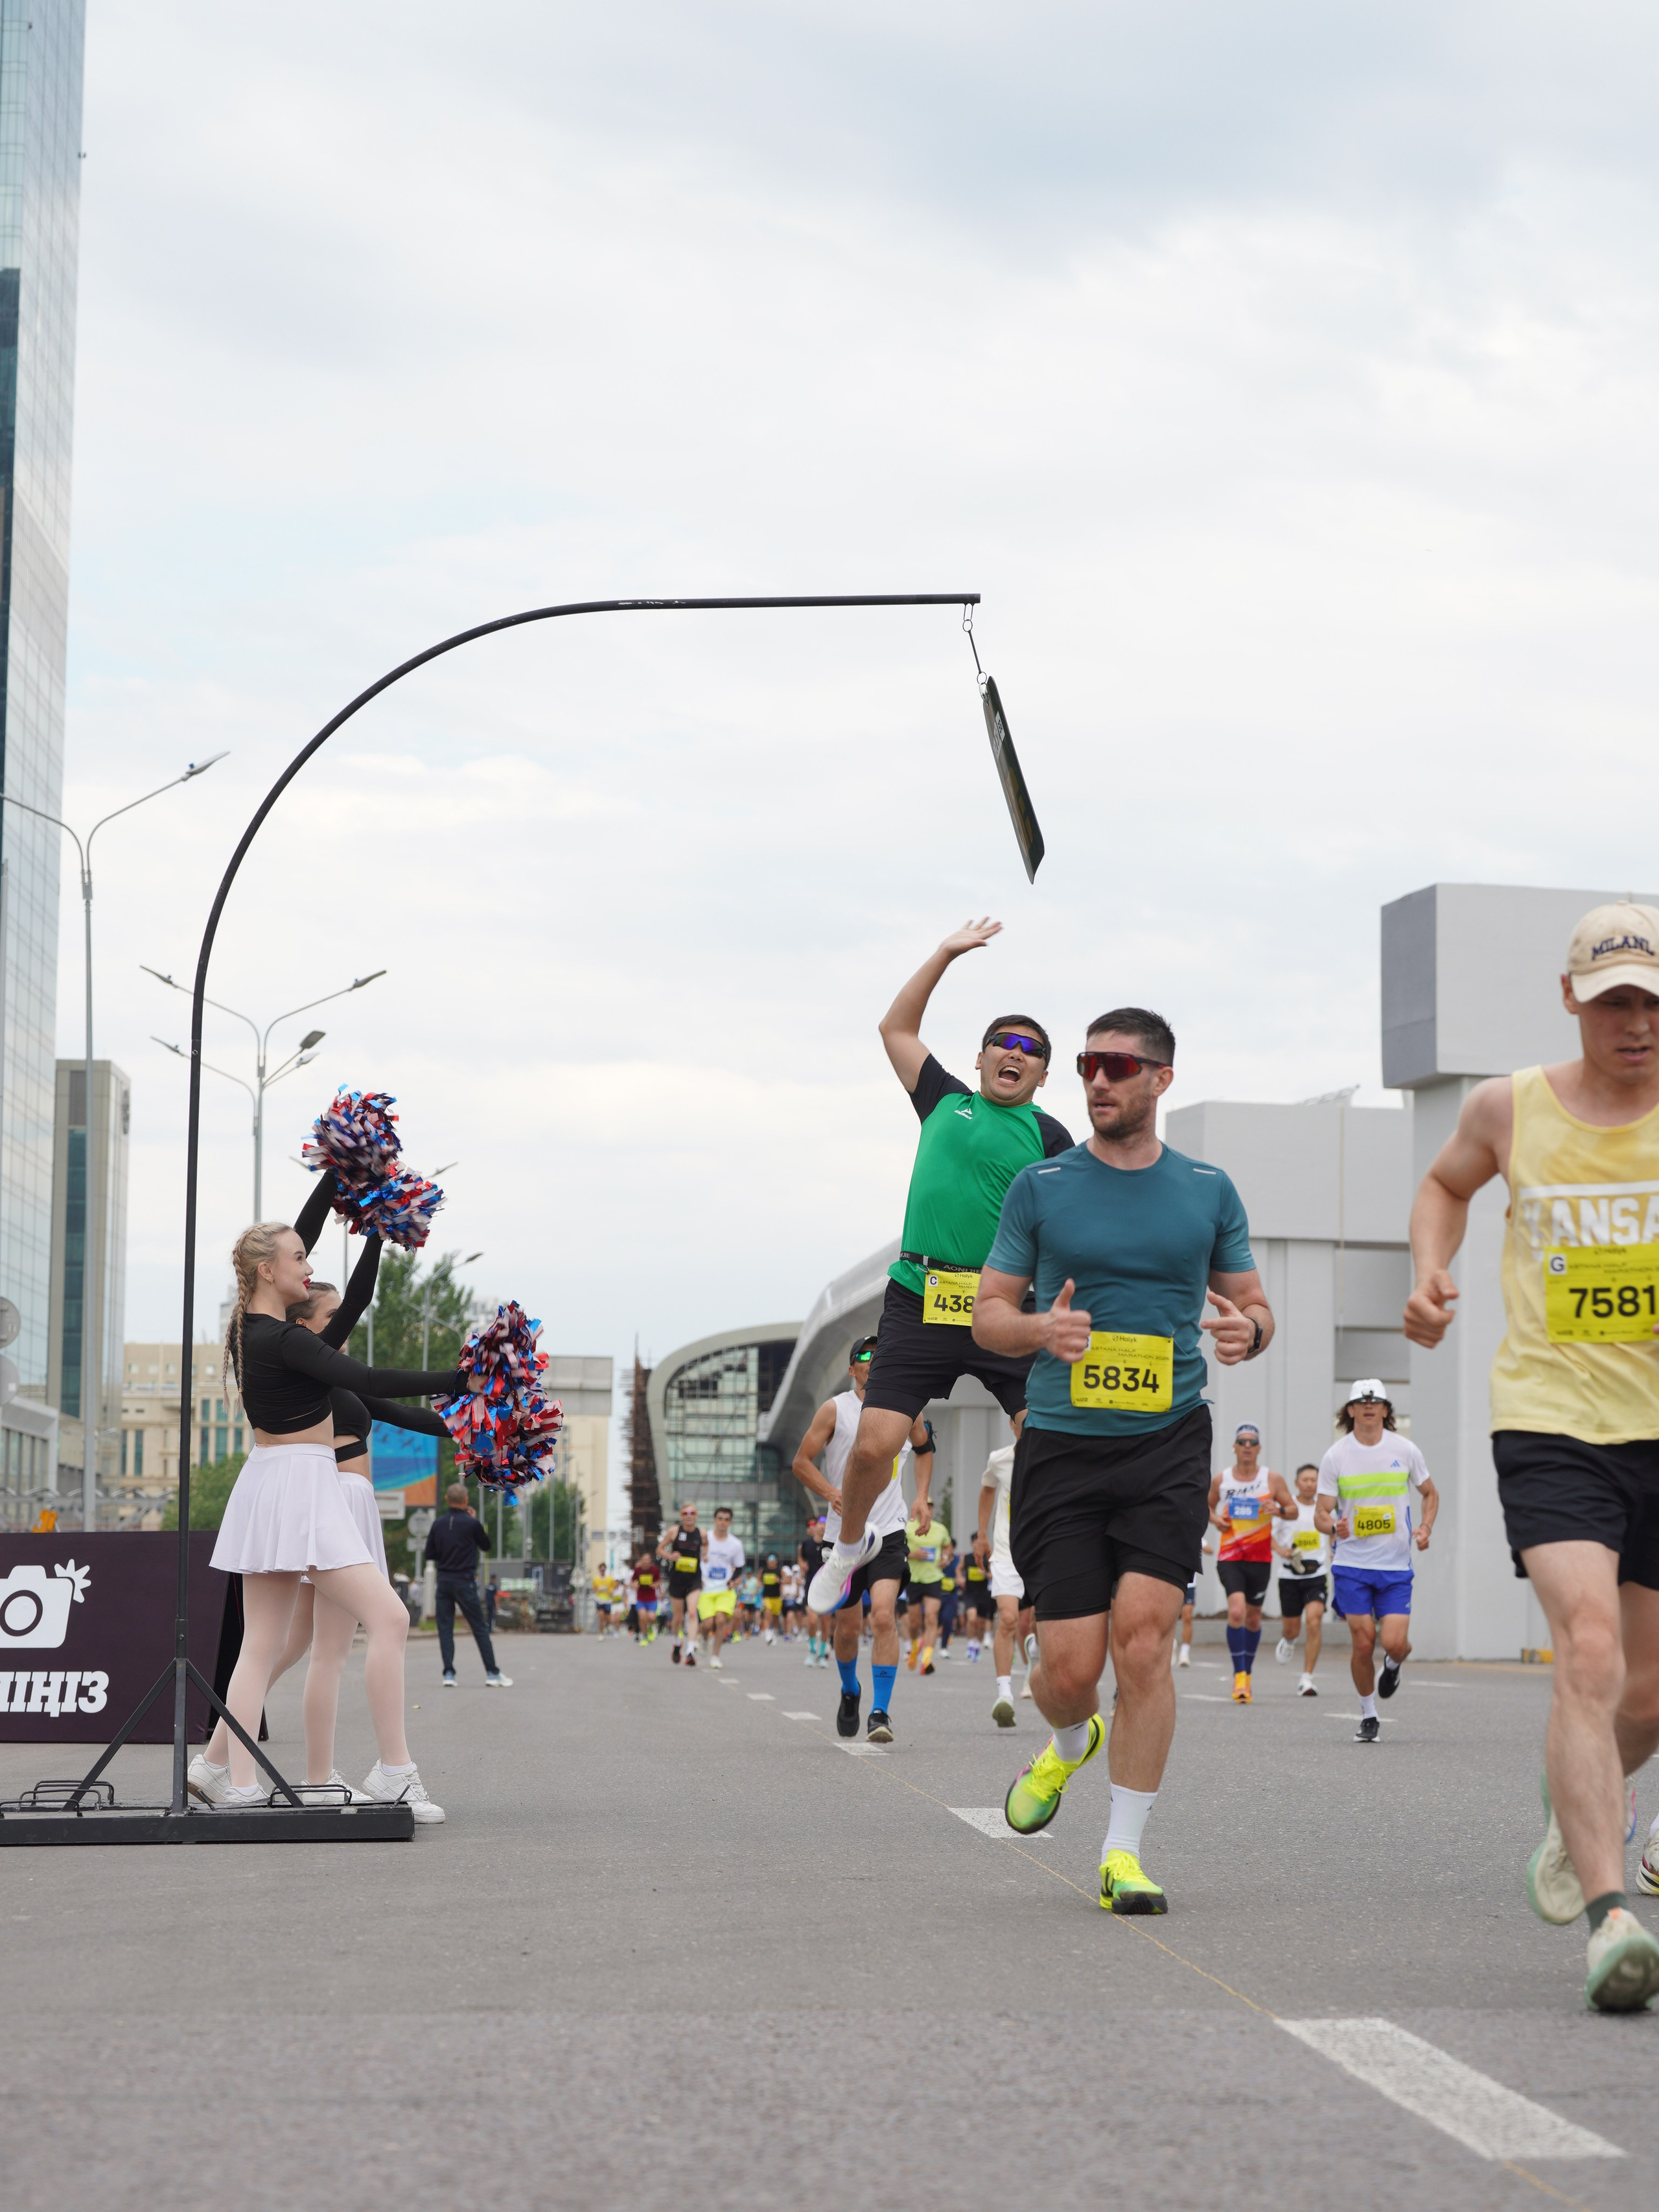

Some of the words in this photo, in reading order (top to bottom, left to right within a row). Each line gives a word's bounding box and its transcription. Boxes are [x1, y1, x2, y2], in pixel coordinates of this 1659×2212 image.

[1551, 1257, 1564, 1272] G
[930, 1276, 937, 1285] C
[934, 1294, 976, 1314] 438
[1569, 1285, 1656, 1318] 7581
[1084, 1364, 1159, 1393] 5834
[1358, 1519, 1391, 1531] 4805
